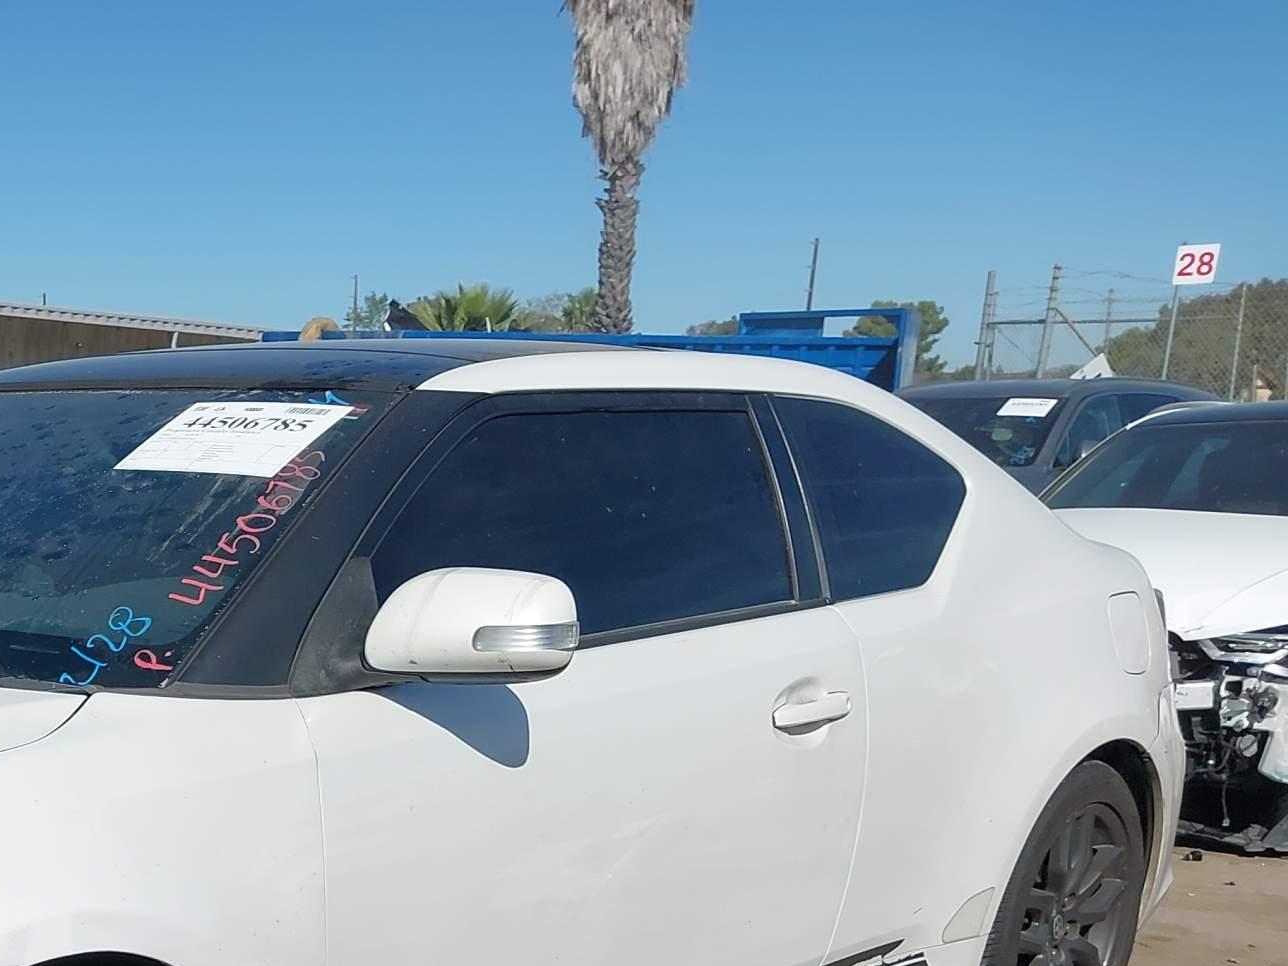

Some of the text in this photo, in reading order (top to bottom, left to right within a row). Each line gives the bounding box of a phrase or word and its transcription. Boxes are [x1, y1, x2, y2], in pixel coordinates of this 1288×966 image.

[1177, 252, 1214, 276] 28
[183, 416, 314, 431] 44506785
[168, 450, 325, 605] 44506785
